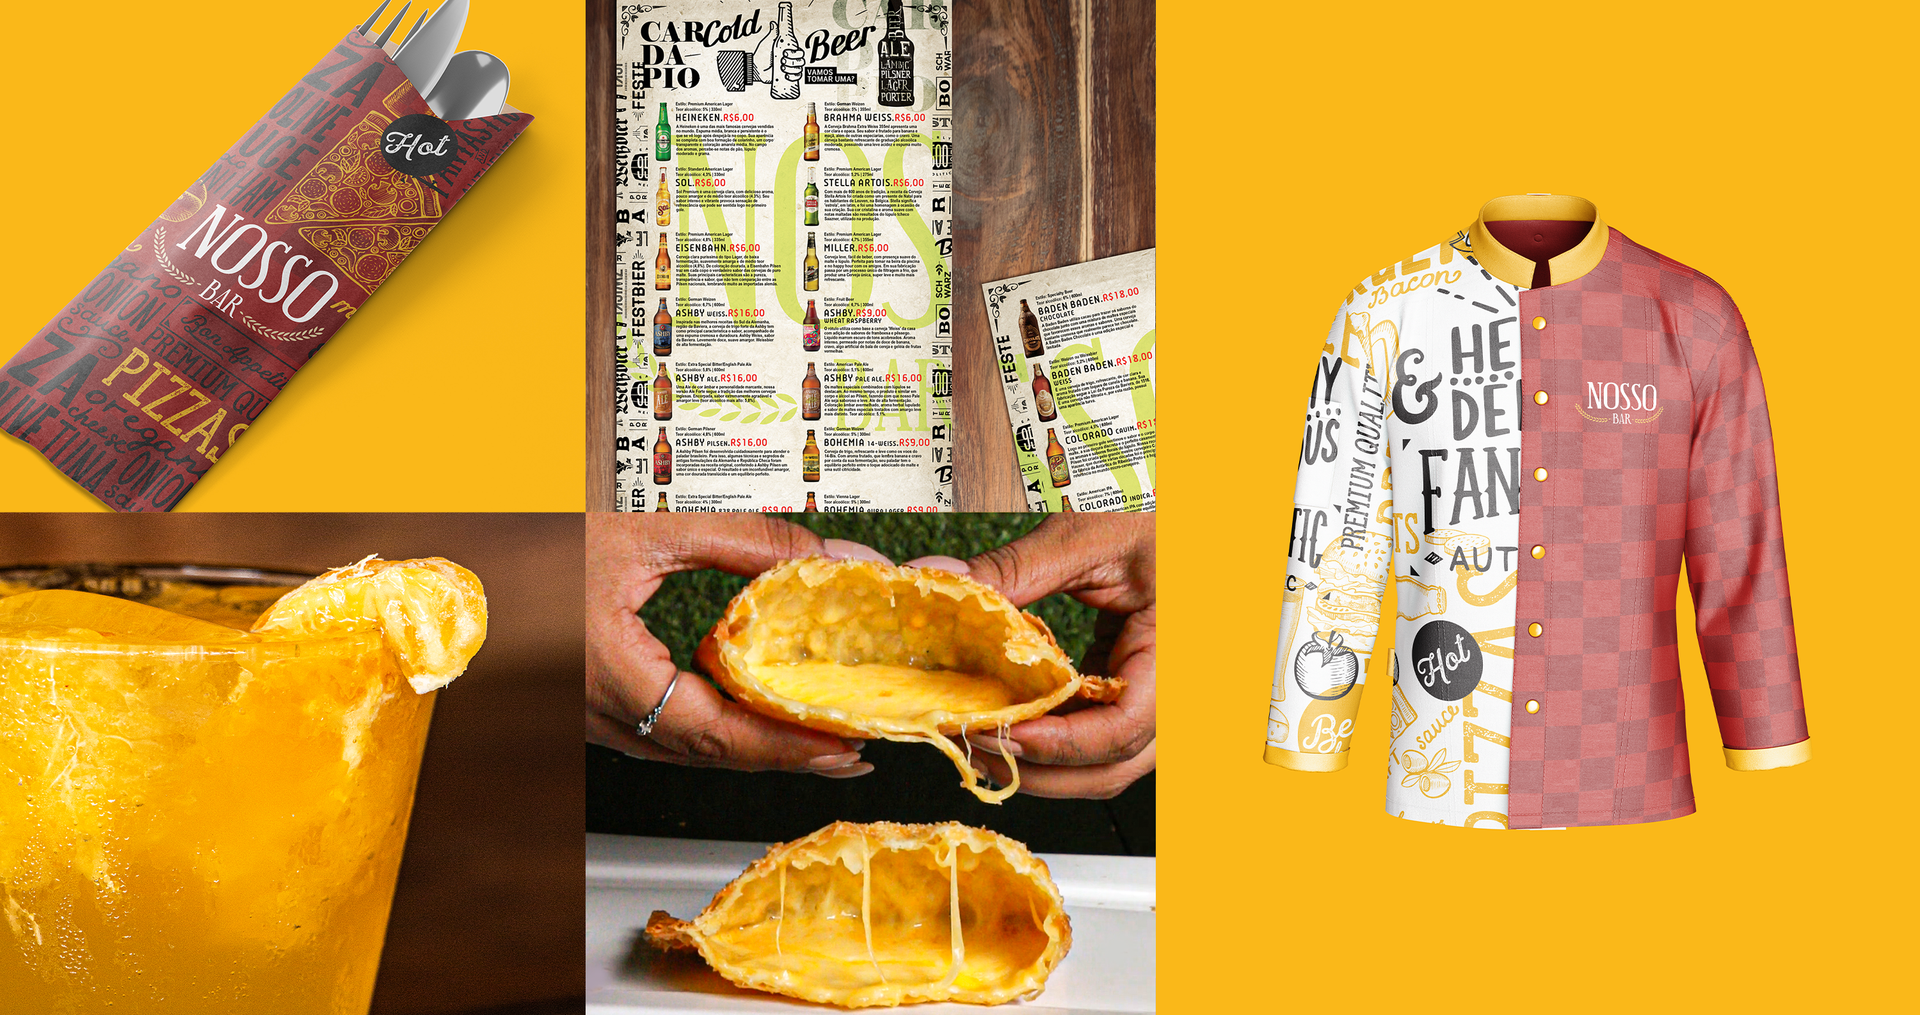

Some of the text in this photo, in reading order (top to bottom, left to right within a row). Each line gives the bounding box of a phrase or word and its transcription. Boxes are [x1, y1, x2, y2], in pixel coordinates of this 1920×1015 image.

[640, 20, 704, 43] CAR
[702, 8, 763, 48] Cold
[805, 25, 876, 64] Beer
[880, 41, 911, 58] ALE
[641, 67, 700, 89] PIO
[807, 75, 855, 83] TOMAR UMA?
[880, 69, 911, 79] PILSNER
[880, 92, 913, 102] PORTER
[268, 86, 353, 144] OLIVE
[824, 113, 862, 122] BRAHMA
[384, 131, 451, 161] Hot
[220, 168, 287, 218] HAM
[824, 178, 856, 187] STELLA
[176, 203, 339, 323] NOSSO
[82, 272, 167, 333] ONION
[198, 278, 244, 319] BAR
[631, 260, 646, 338] FESTBIER
[1367, 270, 1462, 309] Bacon
[69, 302, 130, 343] sauce
[675, 308, 705, 317] ASHBY
[1037, 302, 1068, 316] BADEN
[1039, 309, 1075, 322] CHOCOLATE
[180, 314, 224, 352] Bon
[1451, 316, 1518, 375] HE
[6, 331, 100, 410] ZA
[141, 326, 240, 402] PREMIUM
[675, 373, 705, 382] ASHBY
[824, 373, 853, 382] ASHBY
[1051, 366, 1082, 380] BADEN
[1053, 377, 1073, 387] WEISS
[1587, 381, 1657, 411] NOSSO
[68, 406, 127, 454] cheese
[1612, 412, 1632, 425] BAR
[675, 438, 705, 447] ASHBY
[824, 438, 865, 447] BOHEMIA
[1065, 427, 1114, 445] COLORADO
[1079, 494, 1128, 512] COLORADO
[1340, 457, 1377, 552] PREMIUM
[1418, 446, 1521, 535] FAN
[1449, 545, 1519, 572] AUT
[1417, 633, 1471, 687] Hot
[1416, 704, 1460, 750] sauce
